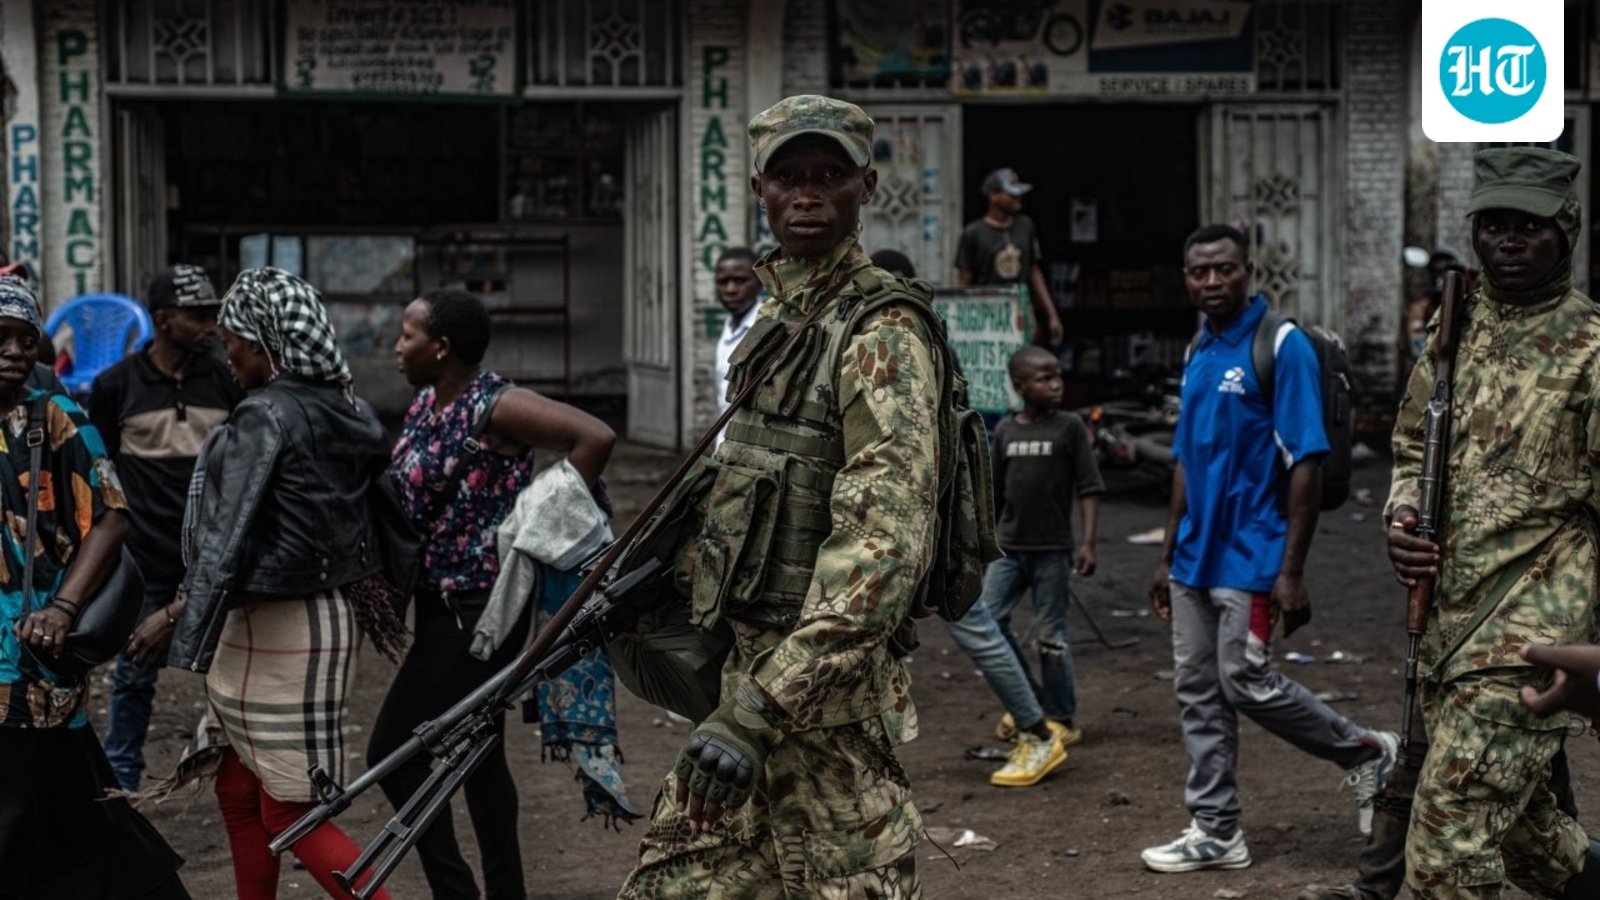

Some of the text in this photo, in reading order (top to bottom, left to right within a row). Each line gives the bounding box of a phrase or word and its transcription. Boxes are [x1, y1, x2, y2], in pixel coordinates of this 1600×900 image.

[1145, 9, 1230, 23] BAJAJ
[1100, 77, 1168, 94] SERVICE
[1186, 77, 1250, 93] SPARES
